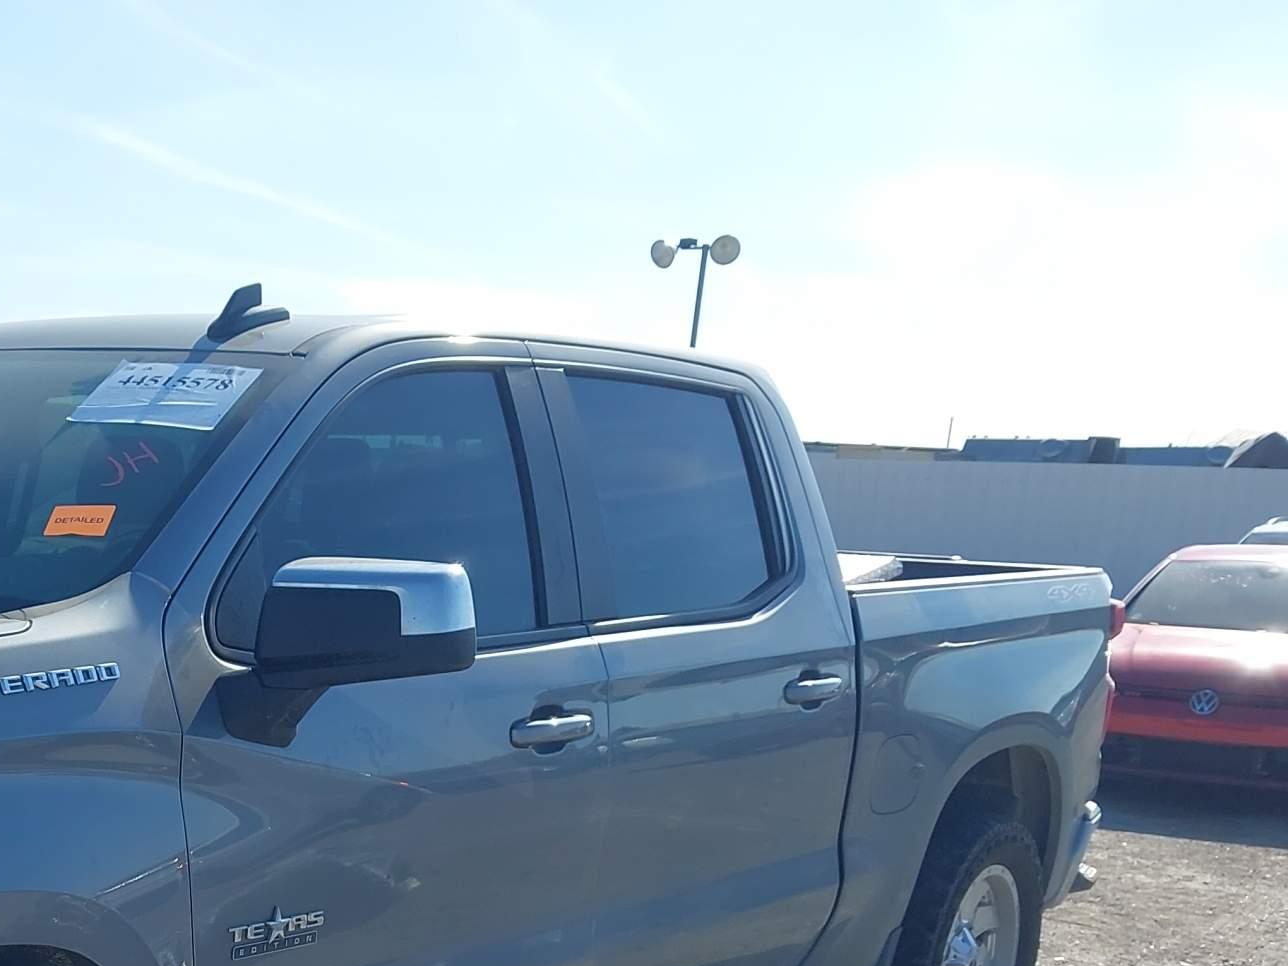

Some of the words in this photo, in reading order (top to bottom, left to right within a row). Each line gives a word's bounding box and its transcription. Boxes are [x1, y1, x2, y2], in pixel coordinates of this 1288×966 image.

[117, 374, 234, 391] 44515578
[53, 516, 105, 524] DETAILED
[238, 934, 313, 956] EDITION
